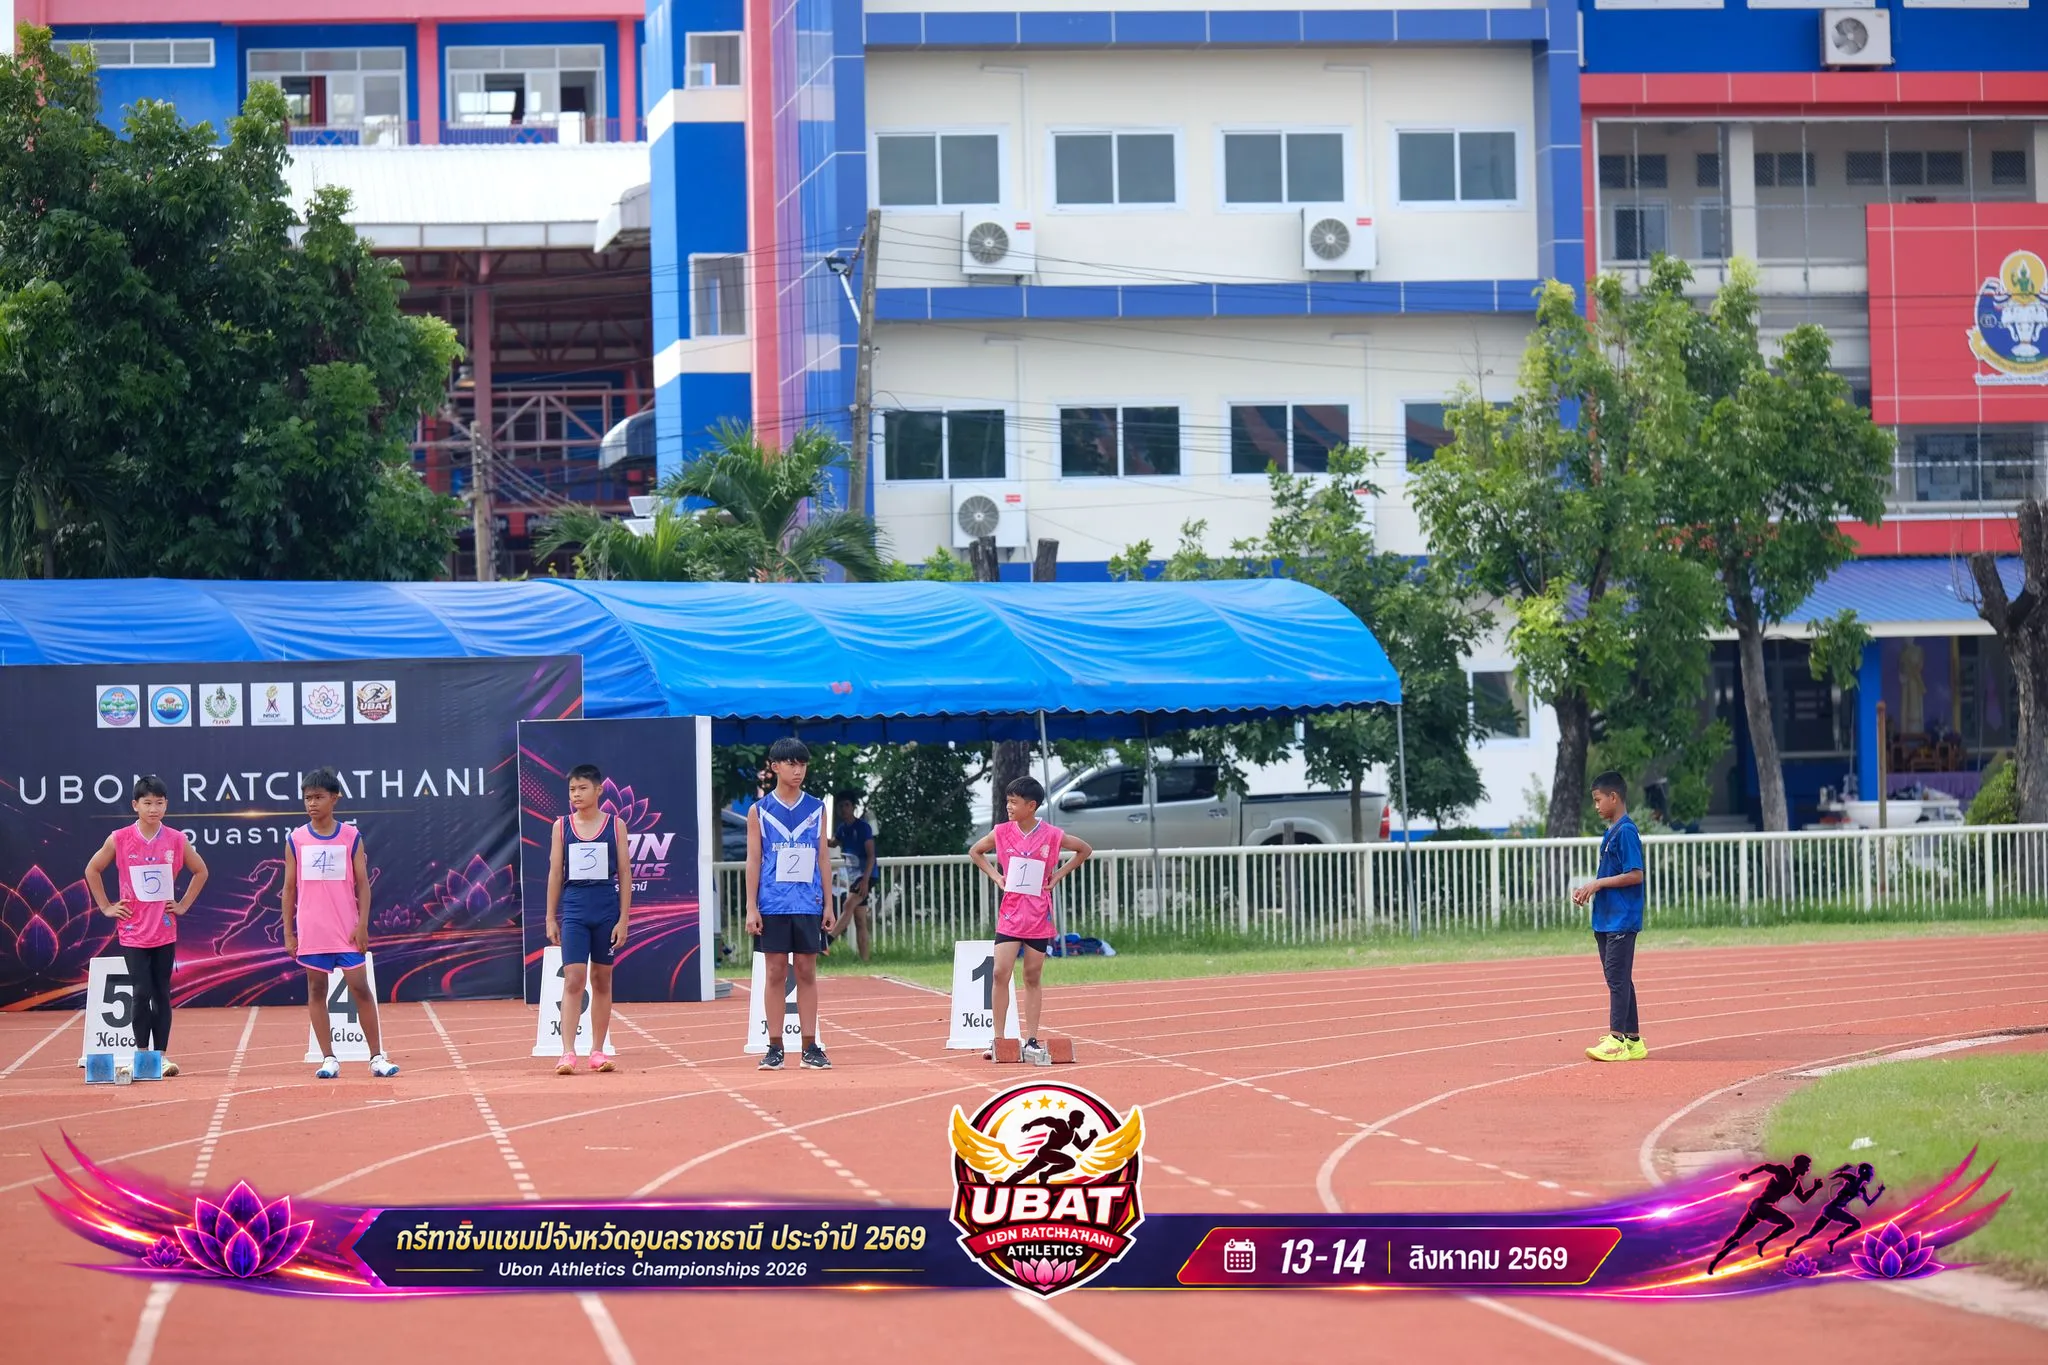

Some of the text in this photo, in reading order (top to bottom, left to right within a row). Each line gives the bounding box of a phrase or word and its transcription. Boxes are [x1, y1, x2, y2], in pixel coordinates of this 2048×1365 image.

[579, 847, 598, 871] 3
[786, 853, 800, 874] 2
[143, 870, 162, 895] 5
[1015, 863, 1031, 887] 1
[971, 955, 994, 1010] 1
[101, 973, 134, 1028] 5
[327, 976, 358, 1024] 4
[96, 1031, 136, 1048] Nelco
